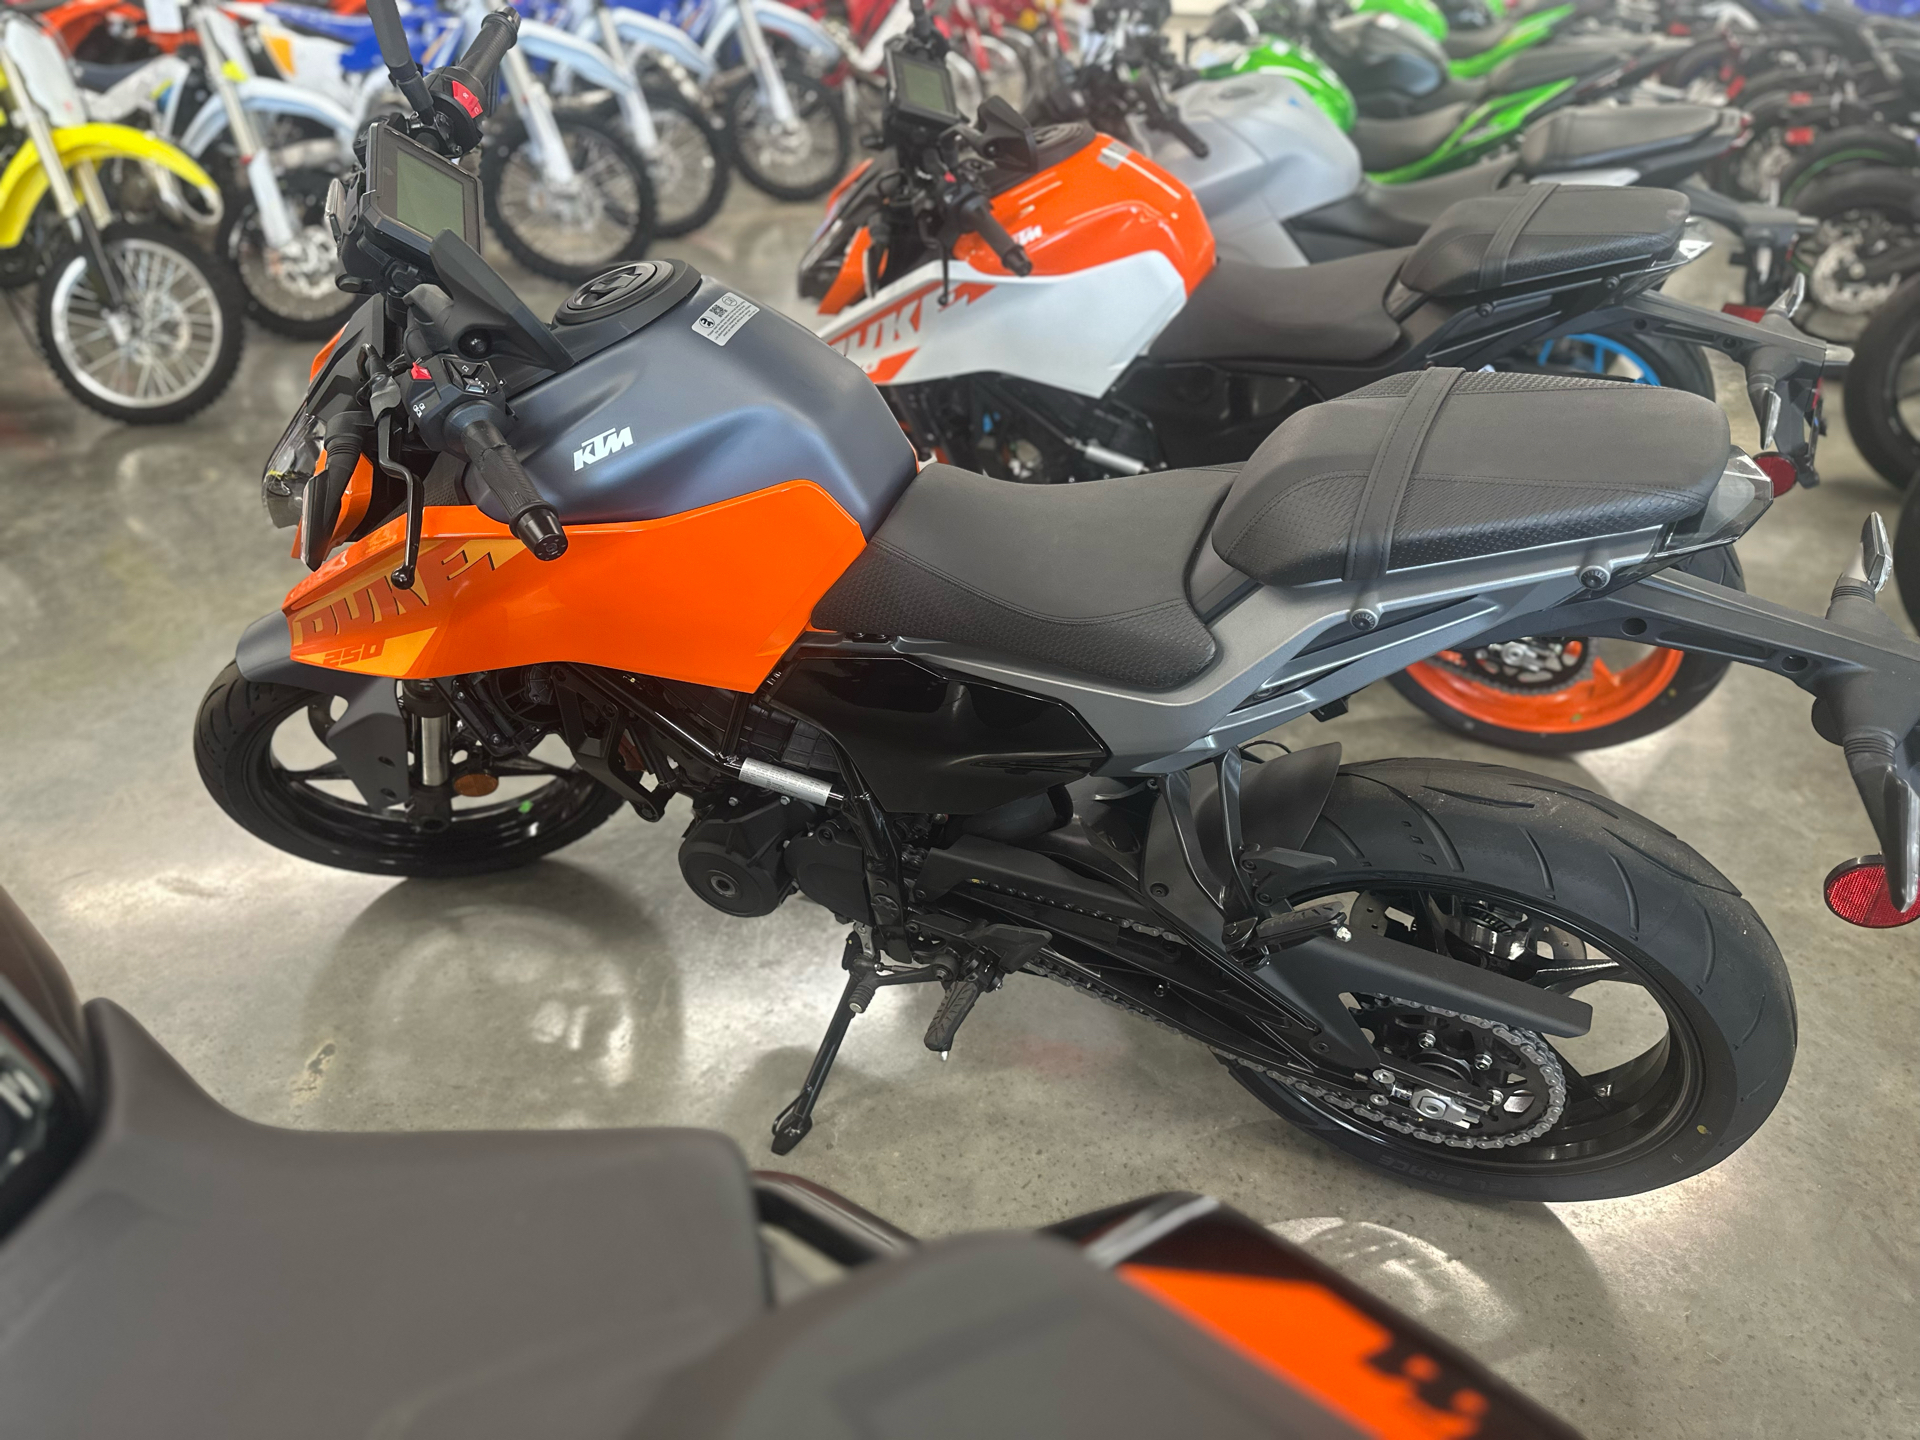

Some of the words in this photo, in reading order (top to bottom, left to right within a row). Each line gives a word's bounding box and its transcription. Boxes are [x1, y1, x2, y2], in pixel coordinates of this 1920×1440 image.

[573, 426, 634, 472] KTM
[299, 541, 496, 645] DUKE
[322, 639, 386, 668] 250
